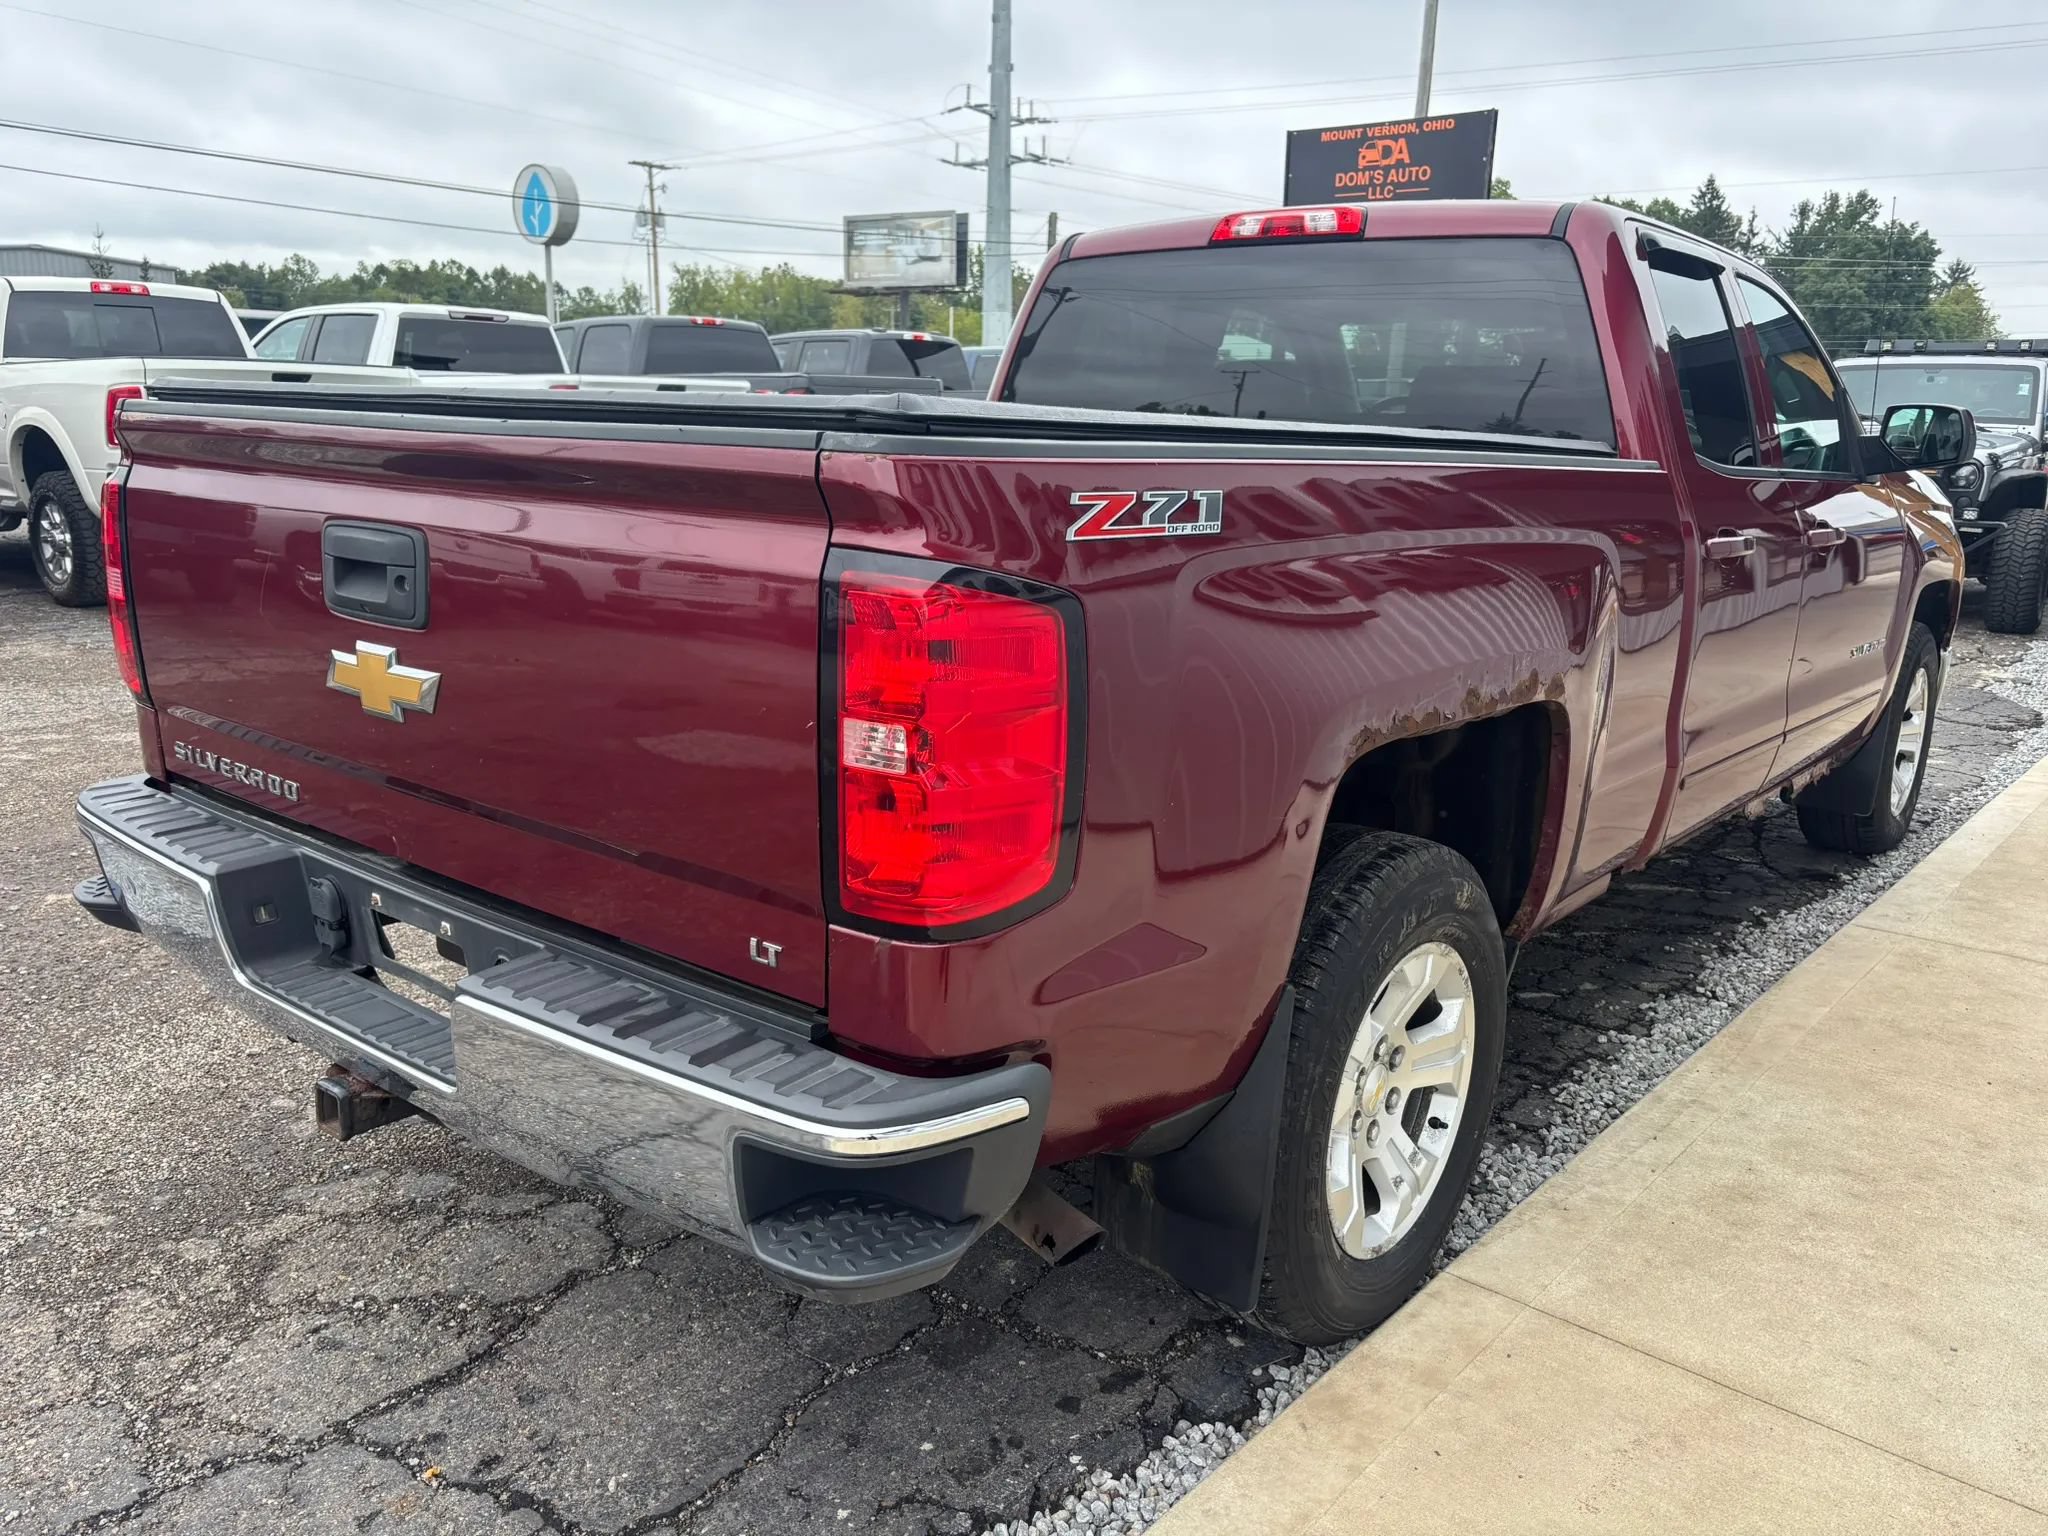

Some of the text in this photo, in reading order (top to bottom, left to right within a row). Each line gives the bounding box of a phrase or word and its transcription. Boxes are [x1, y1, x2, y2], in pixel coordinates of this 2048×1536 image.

[1321, 118, 1456, 142] MOUNT VERNON, OHIO
[1335, 165, 1432, 187] DOM'S AUTO
[1368, 185, 1394, 200] LLC
[1065, 490, 1224, 542] Z71
[1167, 523, 1220, 534] OFF ROAD
[174, 741, 300, 801] SILVERADO
[750, 937, 782, 968] LT
